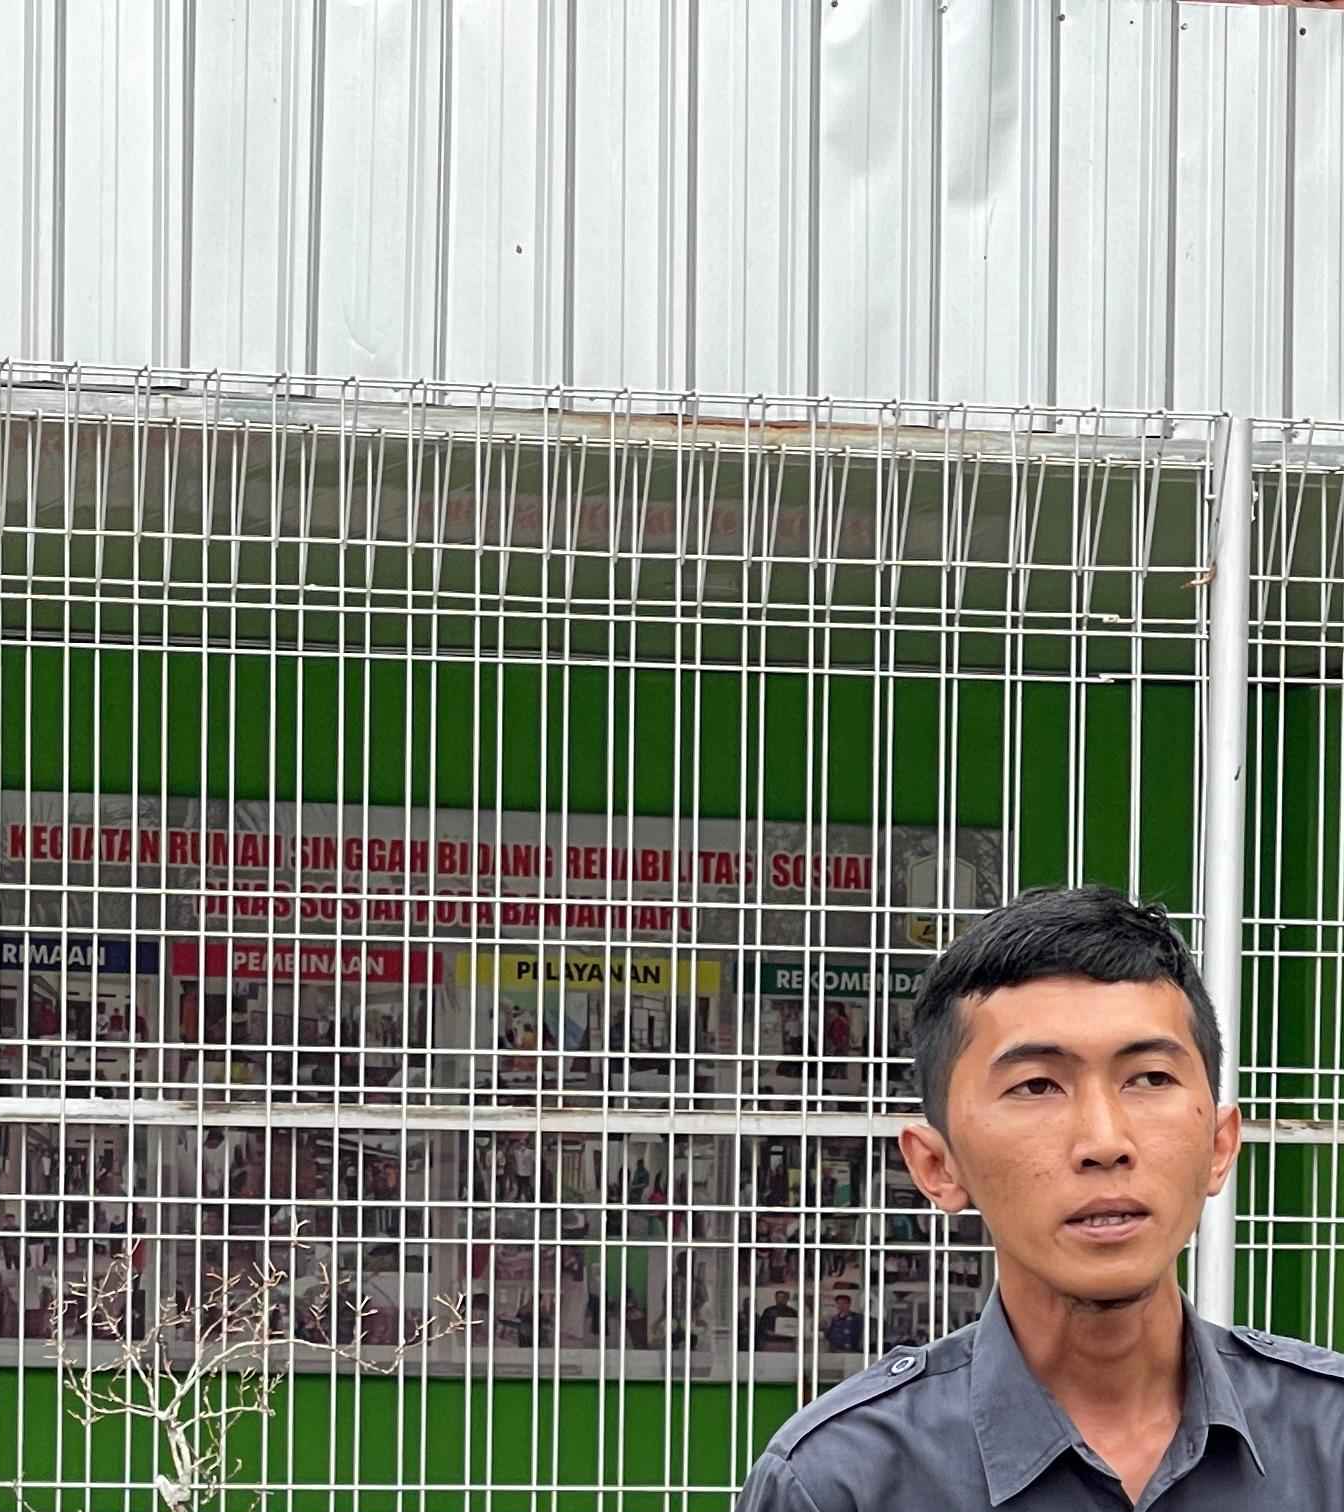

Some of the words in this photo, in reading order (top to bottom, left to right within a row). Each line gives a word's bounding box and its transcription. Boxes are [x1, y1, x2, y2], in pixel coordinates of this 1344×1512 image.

[10, 824, 160, 864] KEGIATAN
[169, 831, 284, 869] RUMAH
[290, 835, 429, 873] SINGGAH
[437, 841, 554, 878] BIDANG
